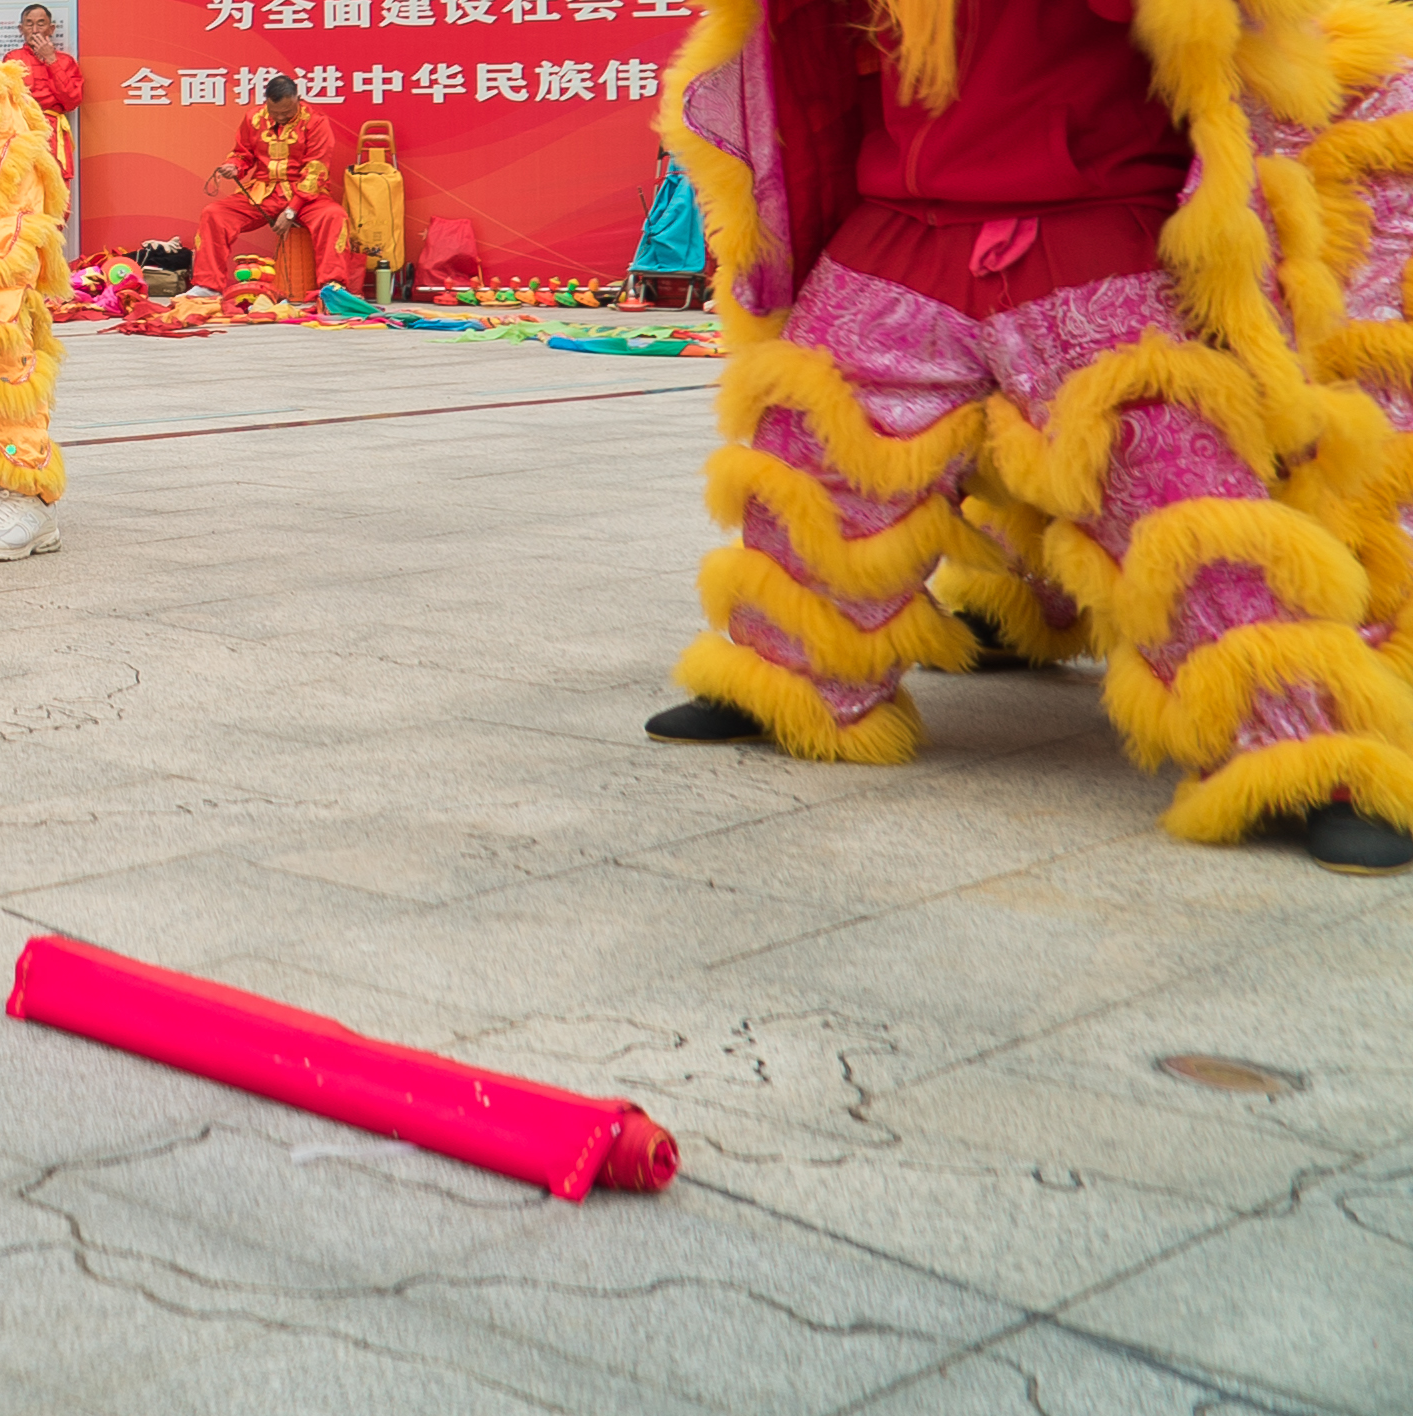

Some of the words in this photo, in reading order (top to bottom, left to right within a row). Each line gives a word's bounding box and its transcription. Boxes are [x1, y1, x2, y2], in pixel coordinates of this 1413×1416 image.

[121, 59, 660, 108] 全面推进中华民族伟
